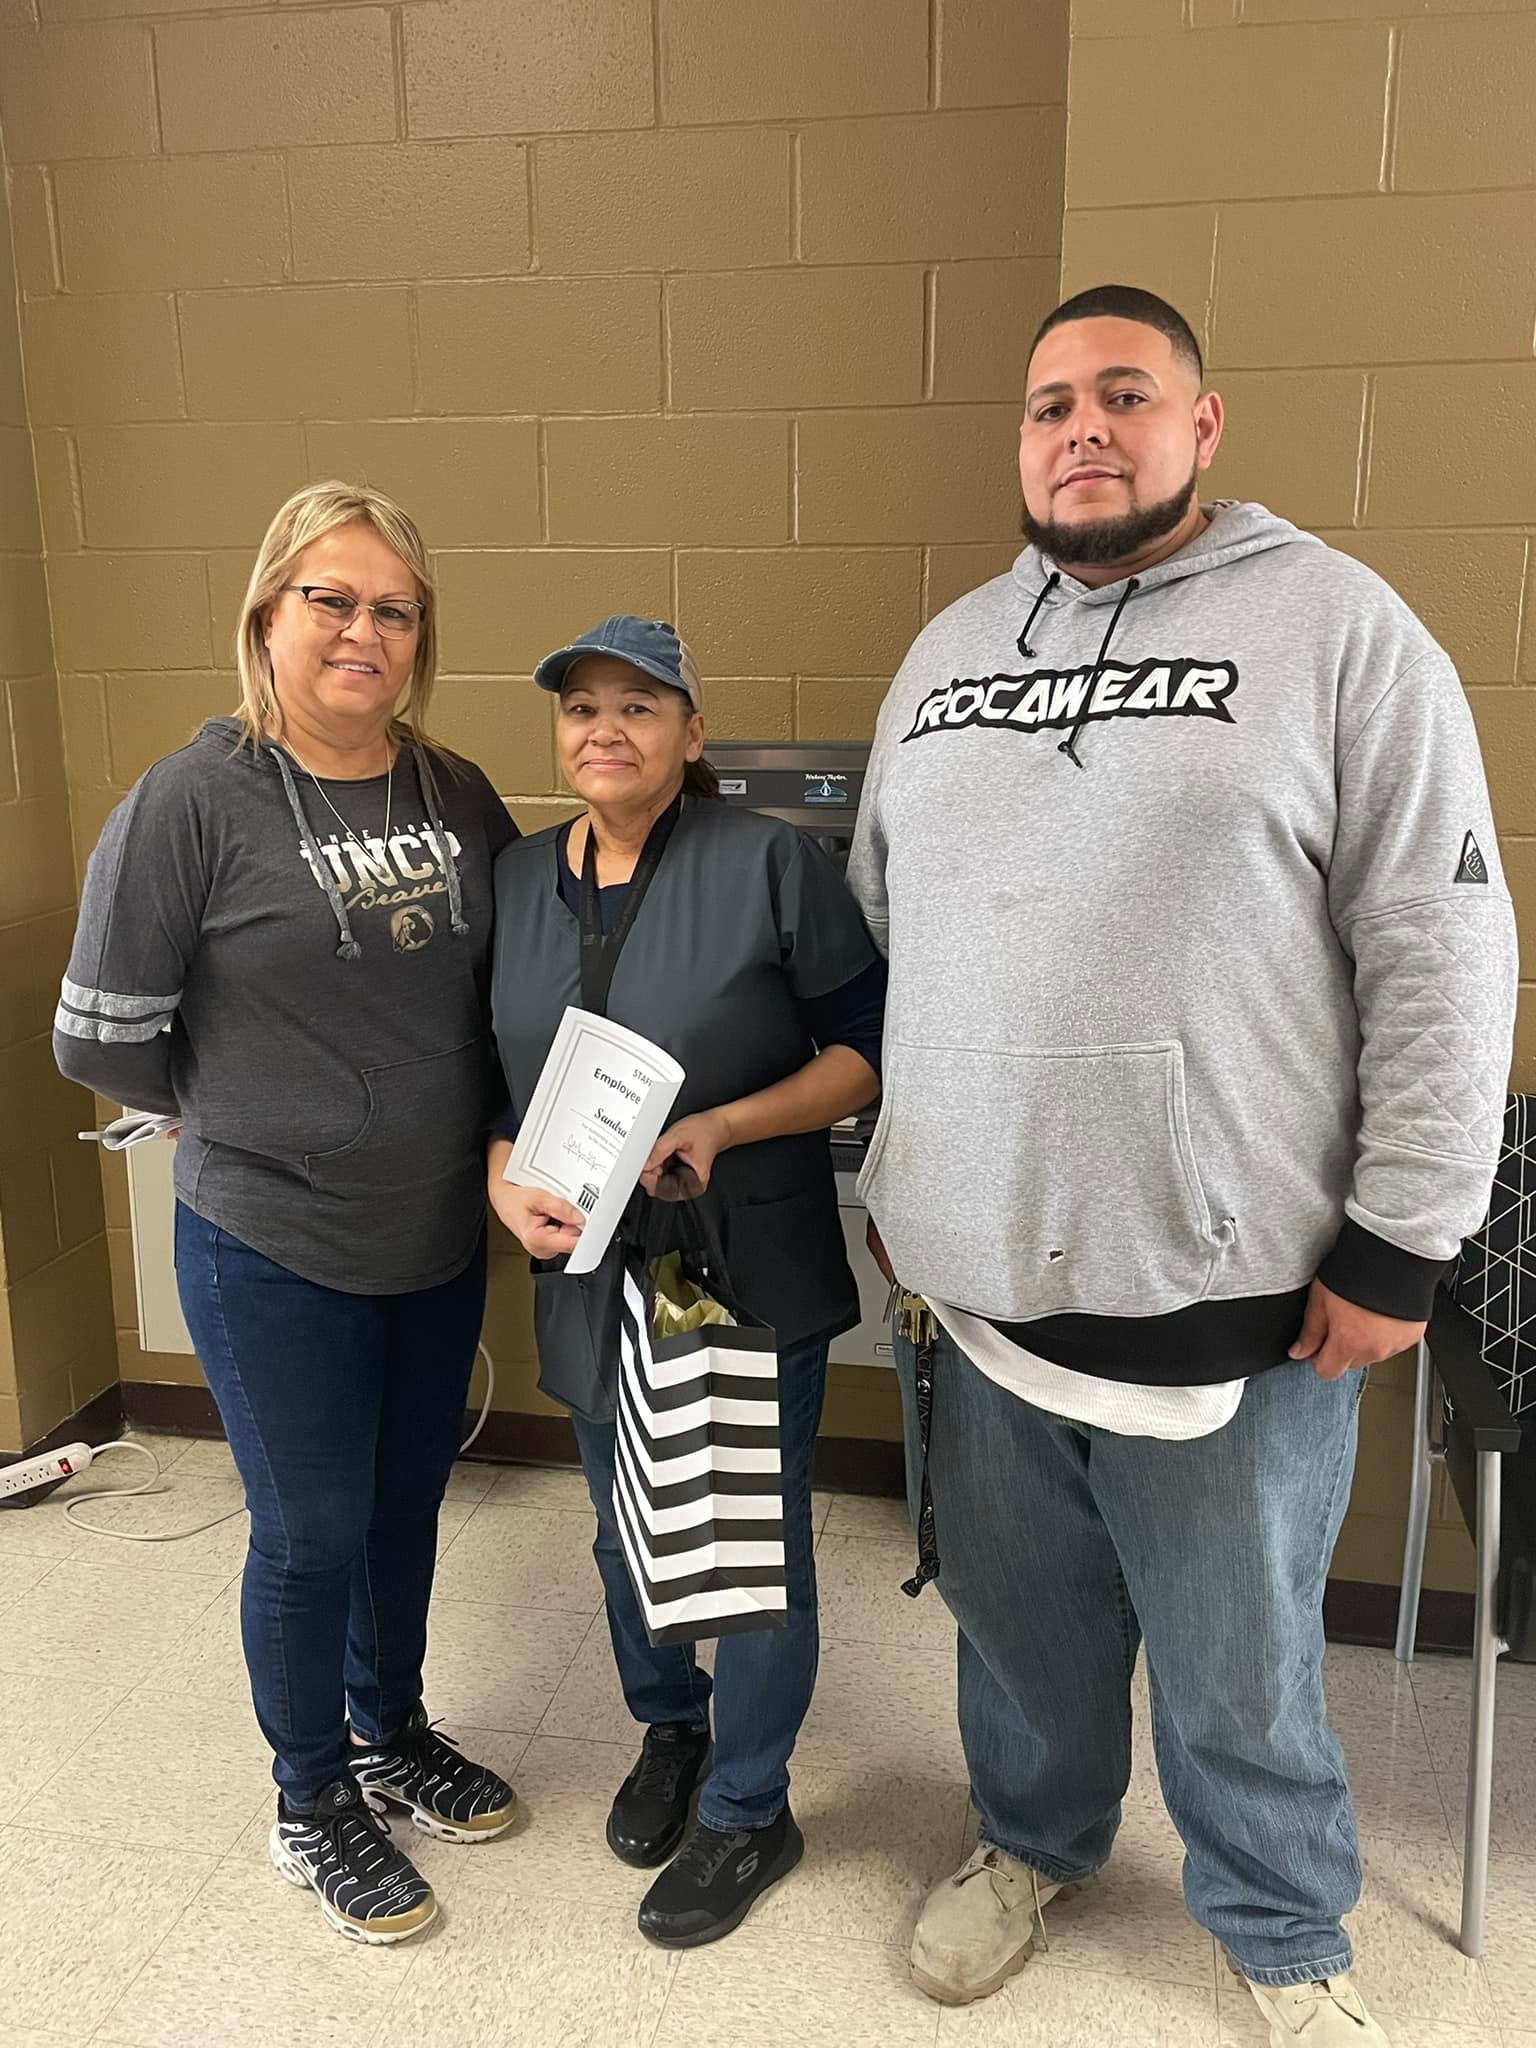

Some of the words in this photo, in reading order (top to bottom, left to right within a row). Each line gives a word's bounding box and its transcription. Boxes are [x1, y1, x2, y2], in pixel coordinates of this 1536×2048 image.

[911, 666, 1231, 734] ROCAWEAR
[299, 829, 372, 850] SINCE
[299, 830, 462, 893] UNCP
[345, 880, 448, 910] Brave
[593, 1067, 642, 1105] Employee
[593, 1107, 628, 1138] Sandra
[916, 1344, 932, 1380] NCP
